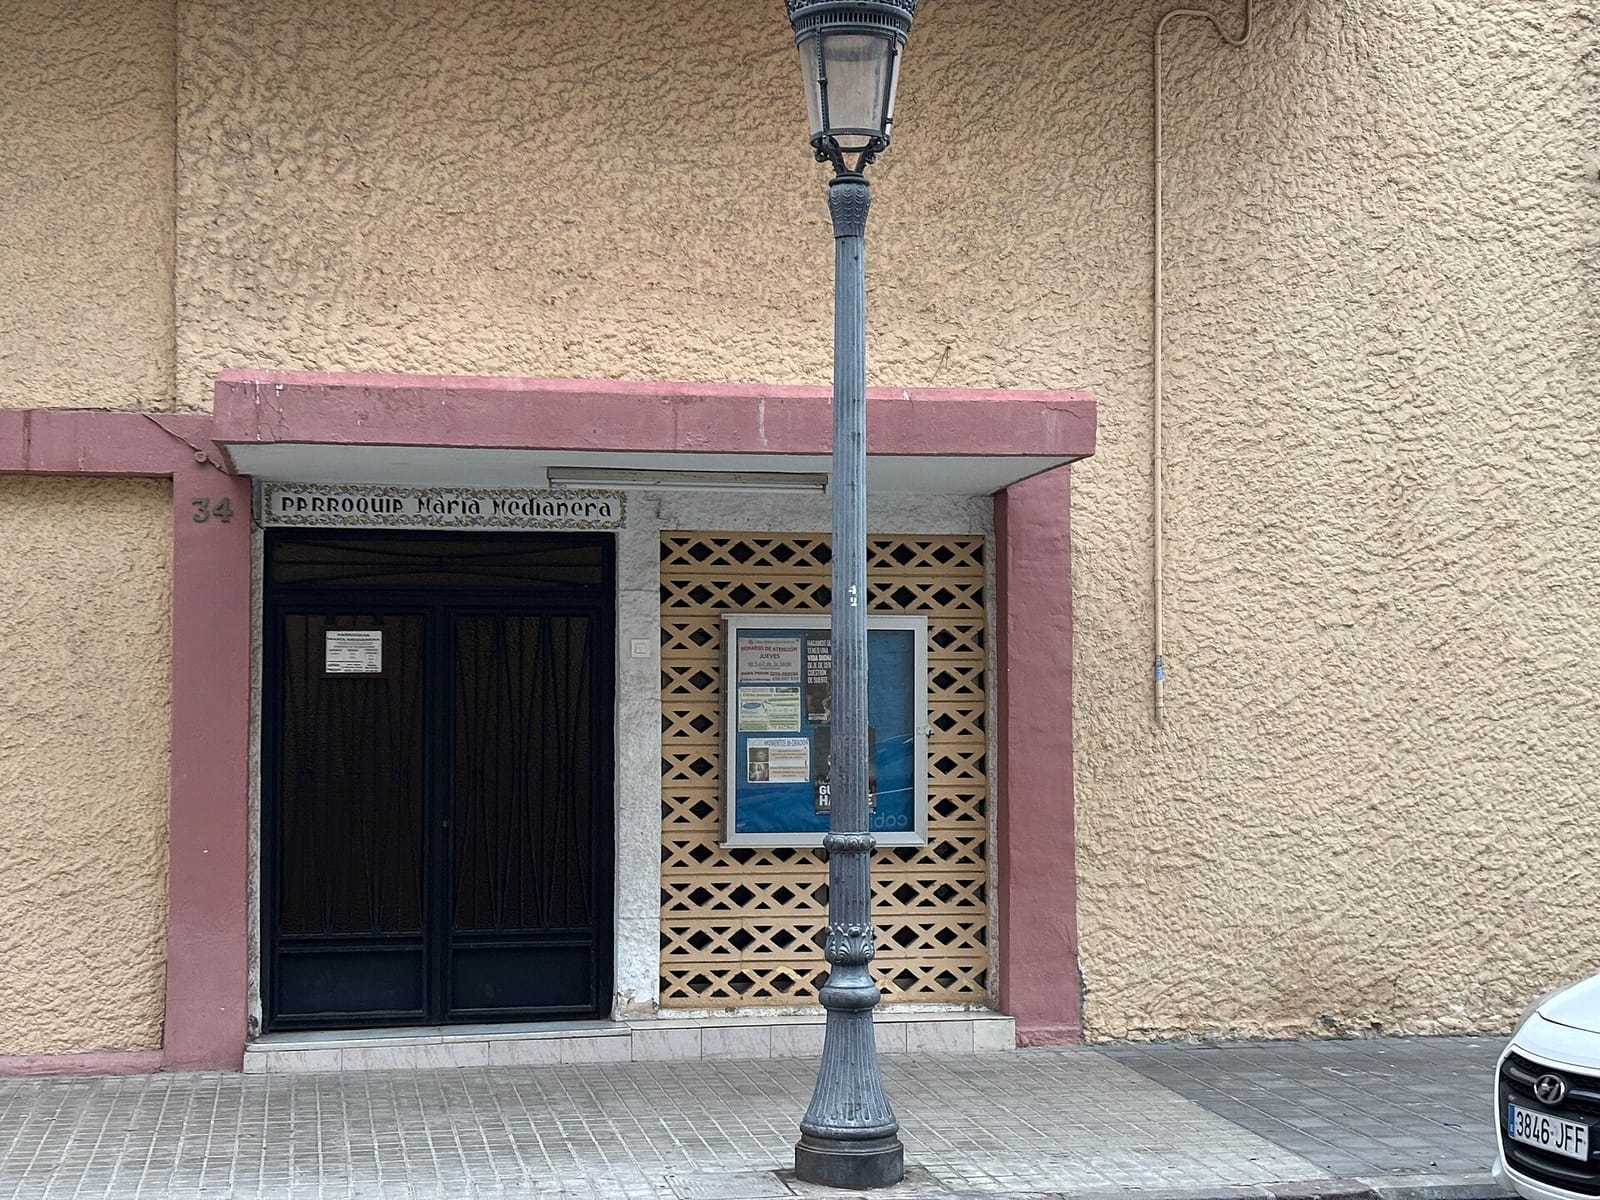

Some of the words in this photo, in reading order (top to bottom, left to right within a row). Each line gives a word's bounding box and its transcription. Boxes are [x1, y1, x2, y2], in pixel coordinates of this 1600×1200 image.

[191, 497, 233, 523] 34
[281, 497, 403, 514] PARROQUIA
[493, 499, 611, 517] Medianera
[1516, 1111, 1550, 1145] 3846
[1555, 1122, 1584, 1154] JFF
